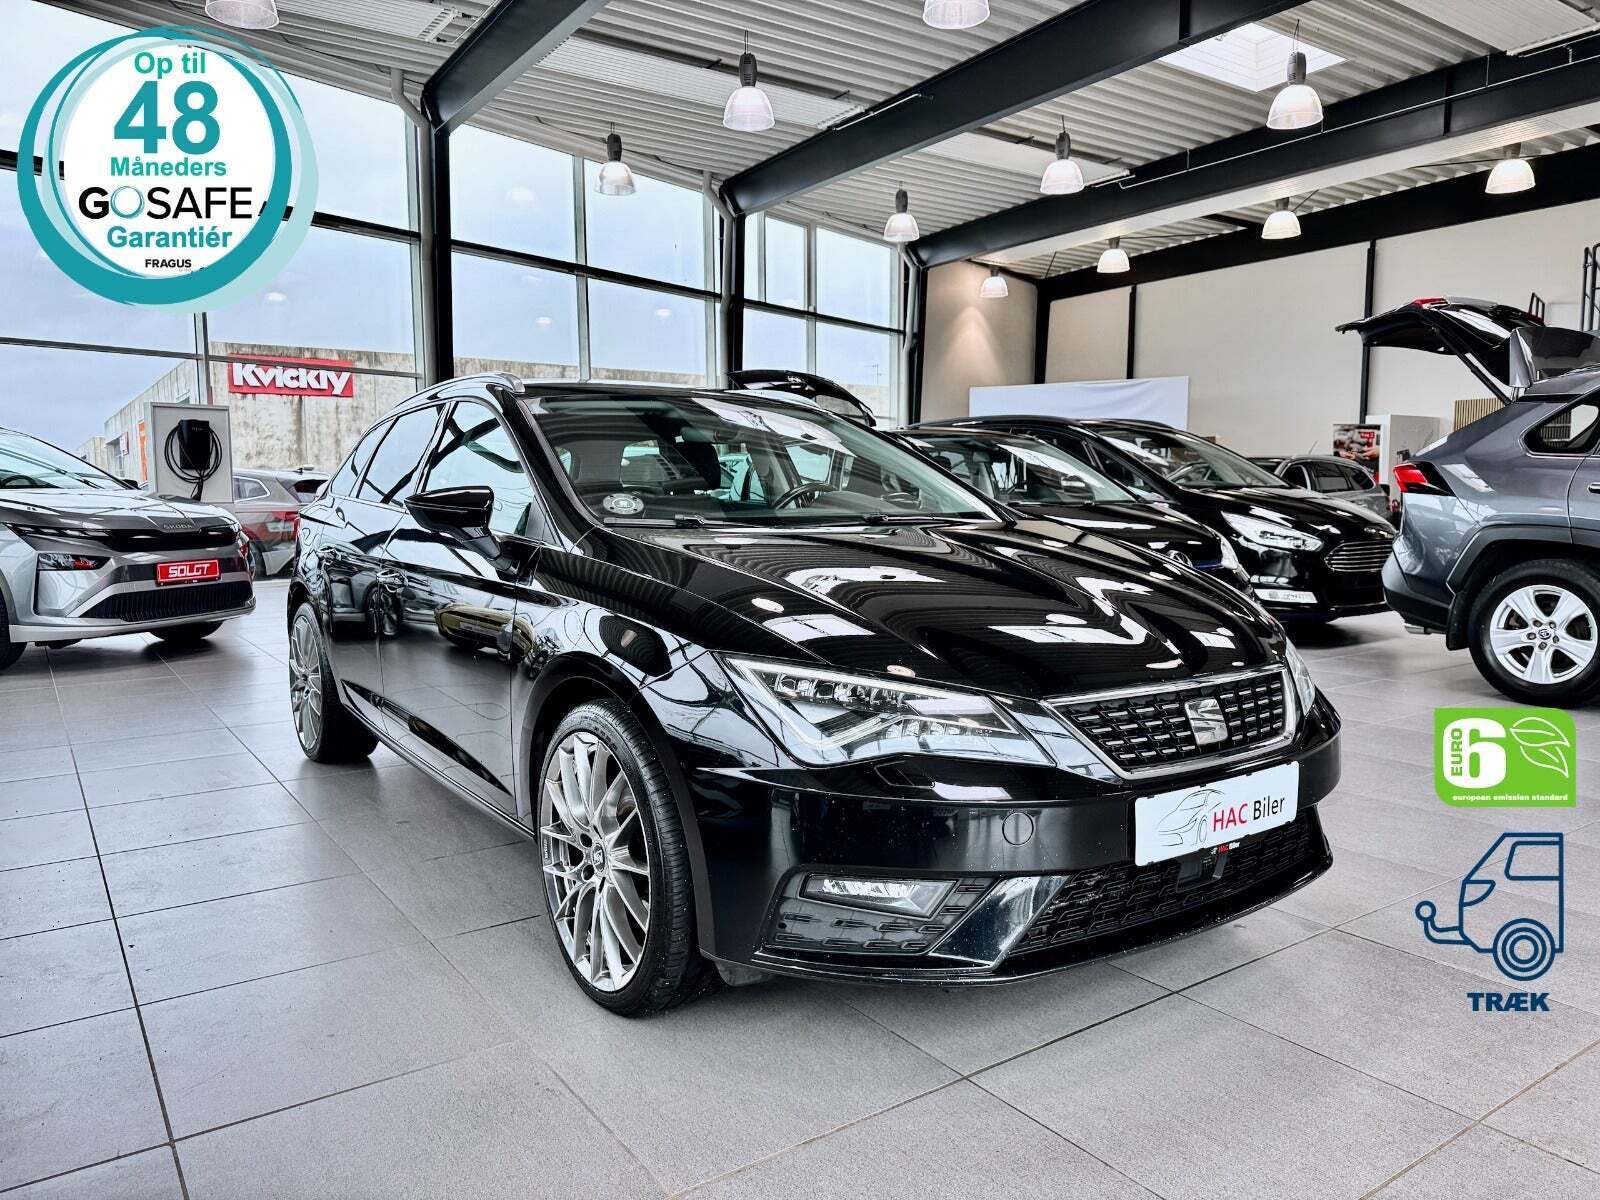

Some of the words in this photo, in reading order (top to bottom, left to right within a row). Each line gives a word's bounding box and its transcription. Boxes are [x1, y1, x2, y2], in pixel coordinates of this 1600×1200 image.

[232, 362, 352, 396] Kvickly
[168, 563, 211, 578] SOLGT
[1213, 803, 1248, 832] HAC
[1253, 795, 1285, 821] Biler
